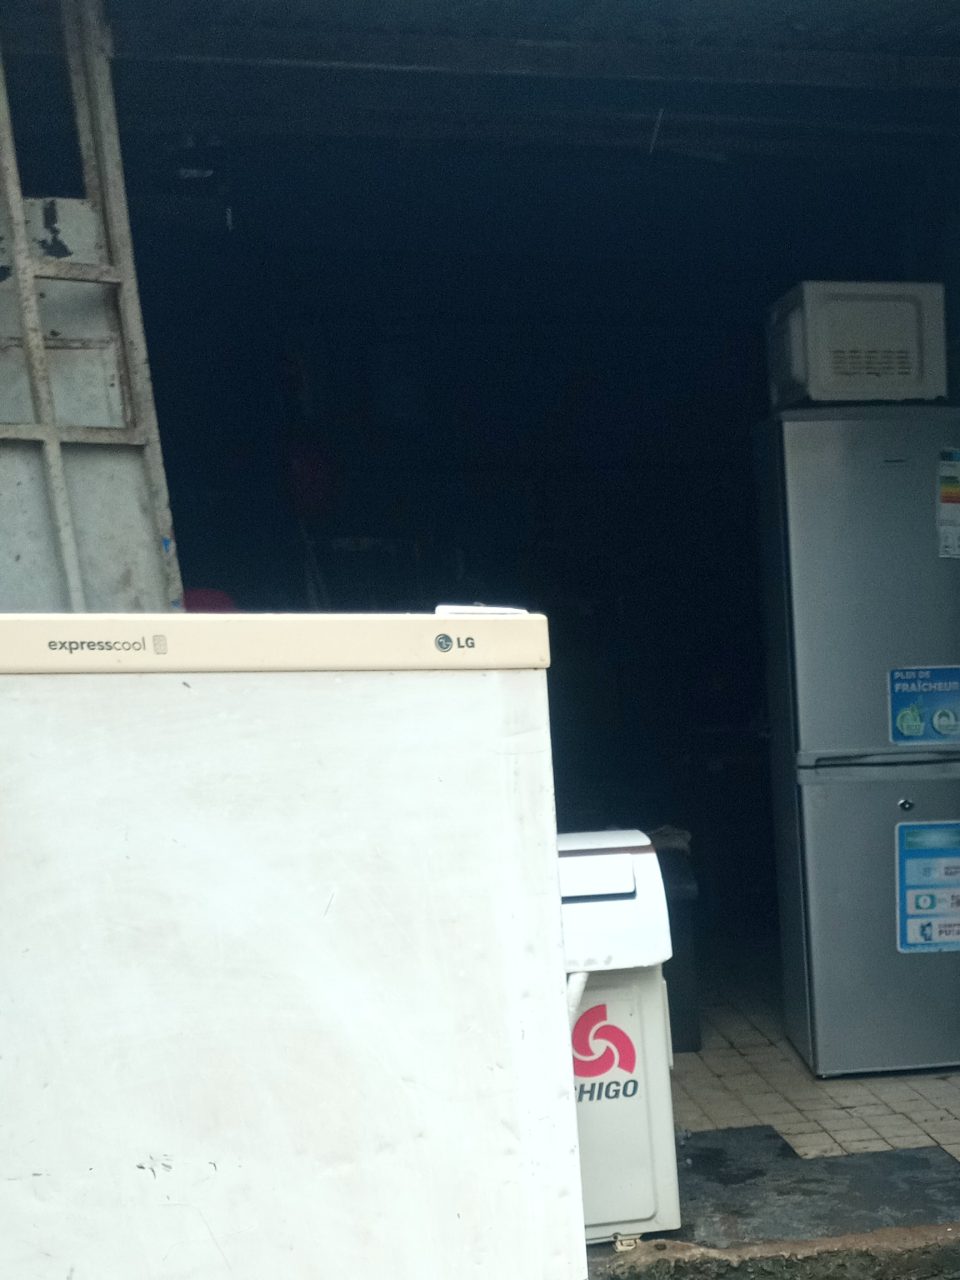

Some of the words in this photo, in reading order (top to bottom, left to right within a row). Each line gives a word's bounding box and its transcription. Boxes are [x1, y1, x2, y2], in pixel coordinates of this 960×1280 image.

[48, 636, 146, 654] expresscool
[456, 636, 475, 649] LG
[575, 1079, 639, 1102] HIGO
